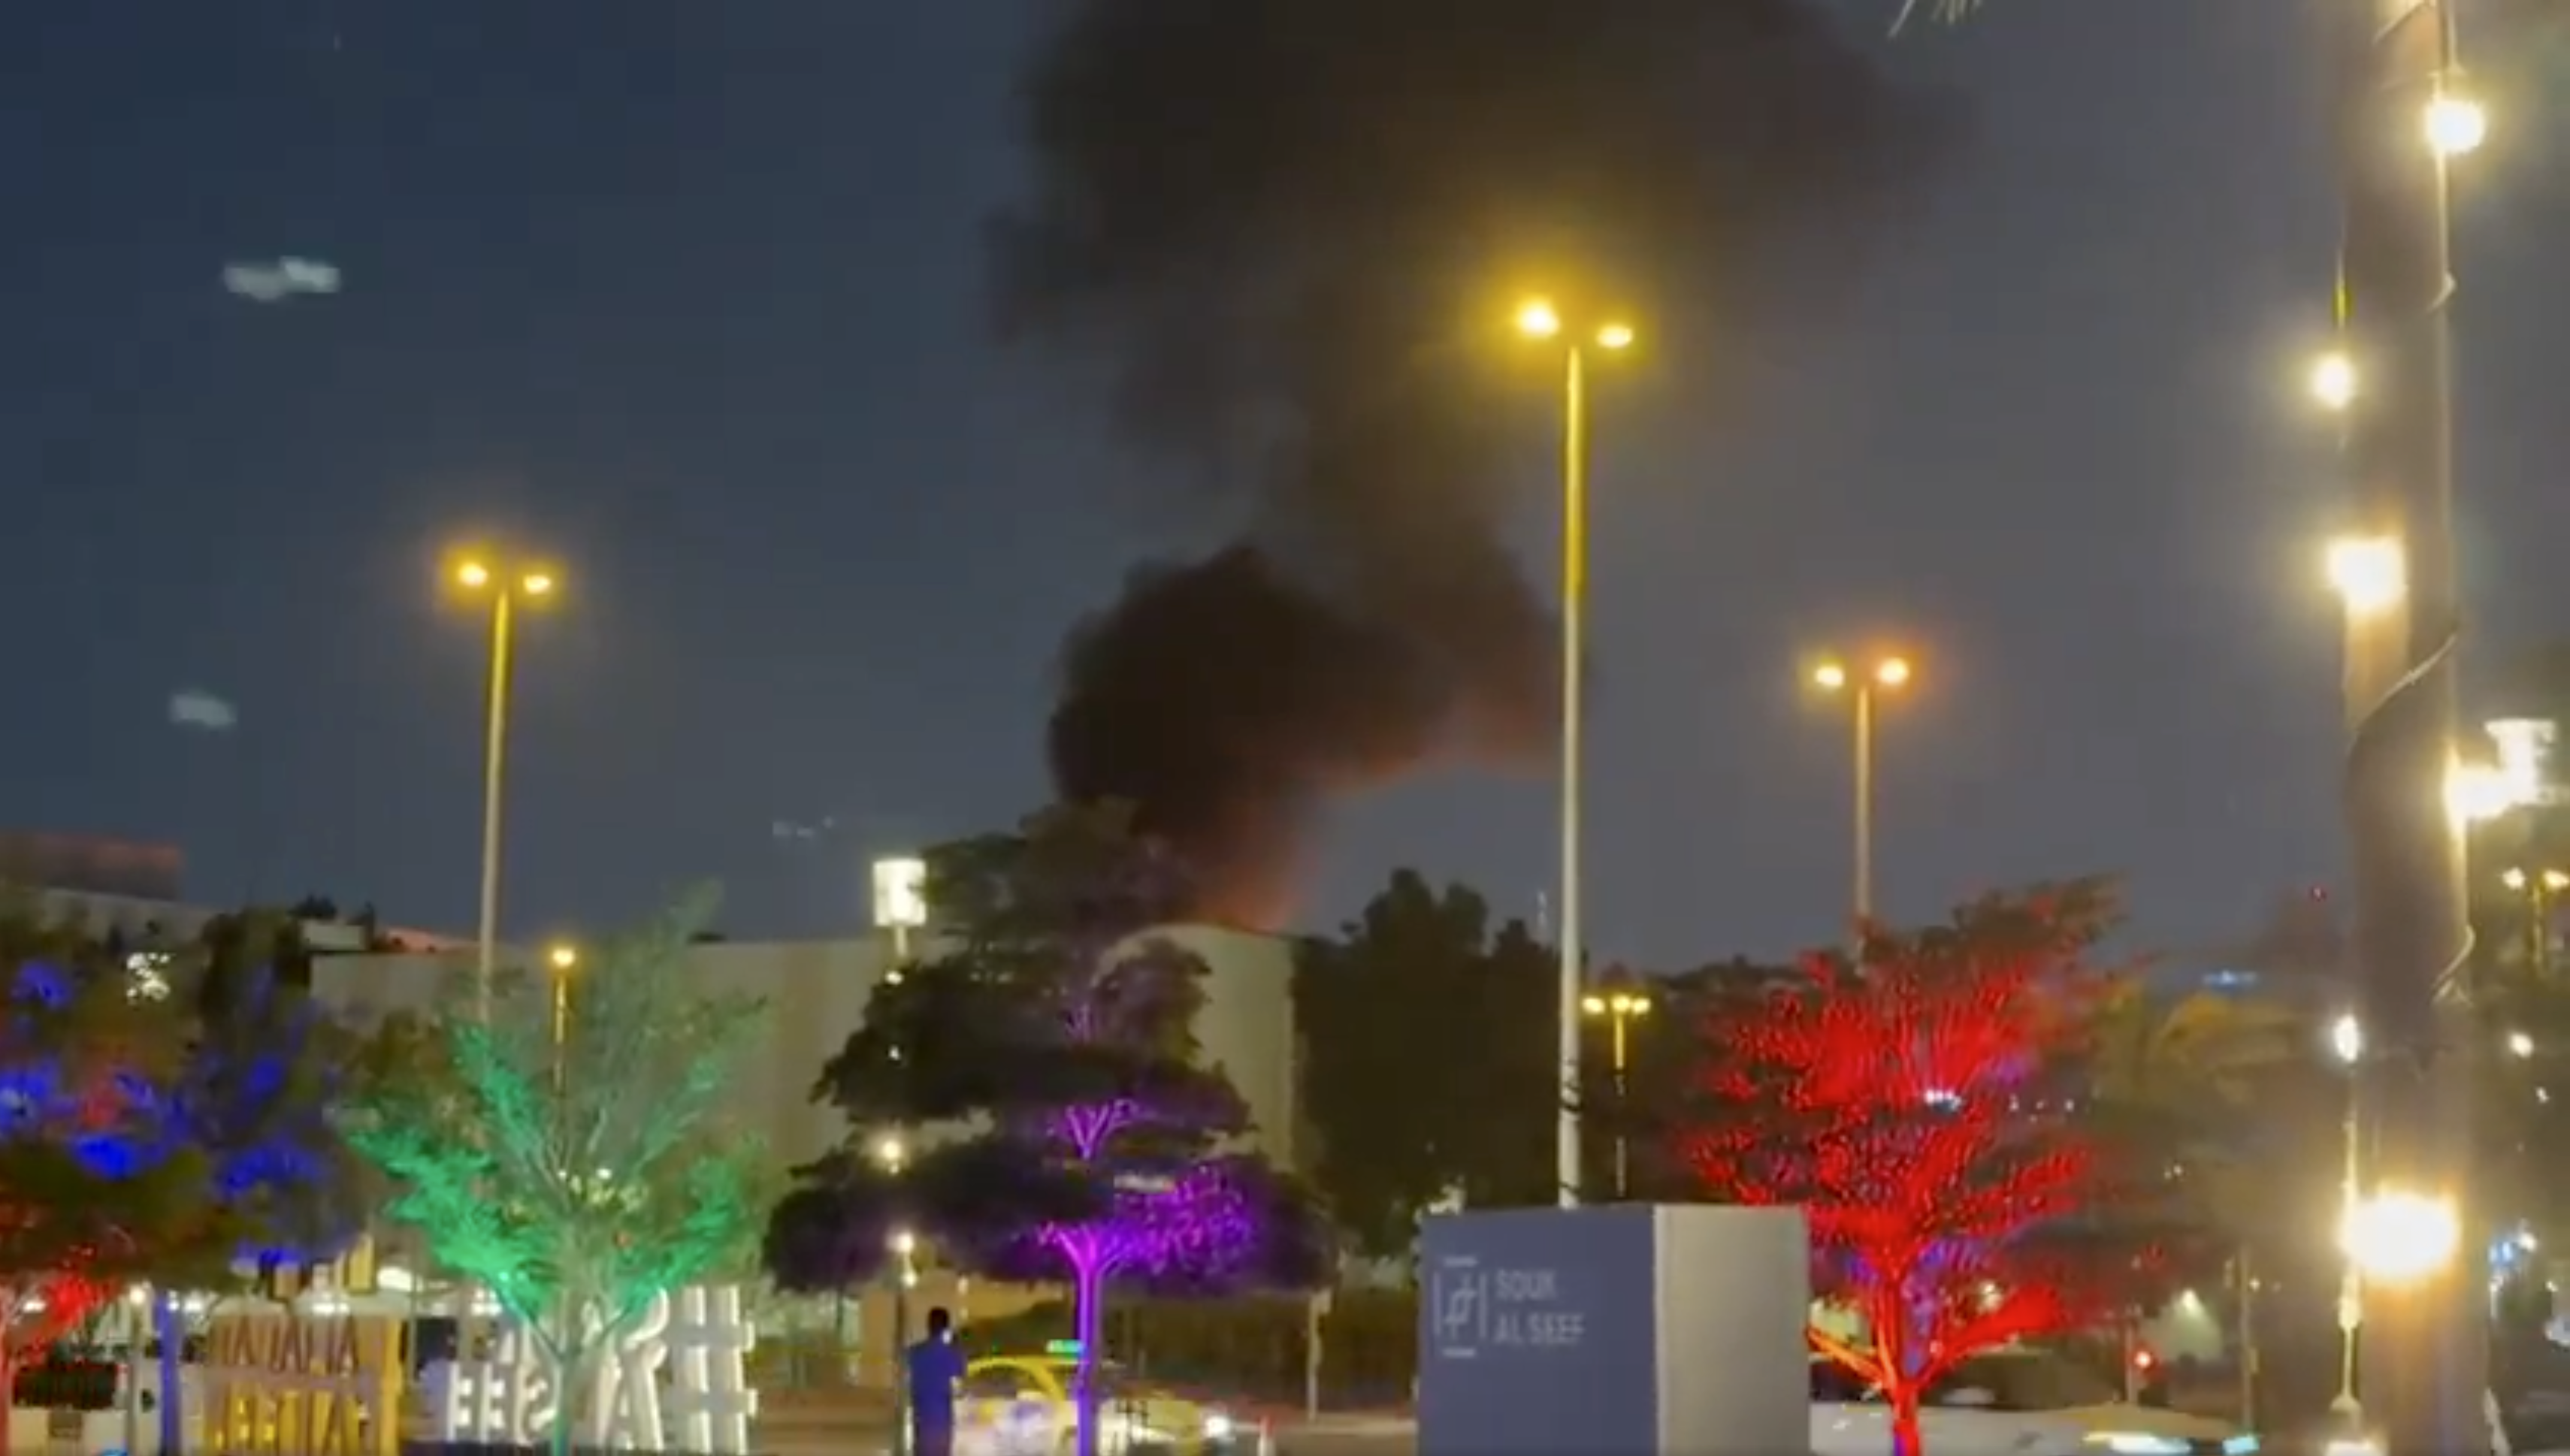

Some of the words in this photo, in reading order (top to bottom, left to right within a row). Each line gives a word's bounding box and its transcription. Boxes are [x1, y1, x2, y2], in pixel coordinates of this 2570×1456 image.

[1495, 1268, 1556, 1300] SOUK
[1493, 1312, 1523, 1344] AL
[1527, 1312, 1585, 1344] SEEF
